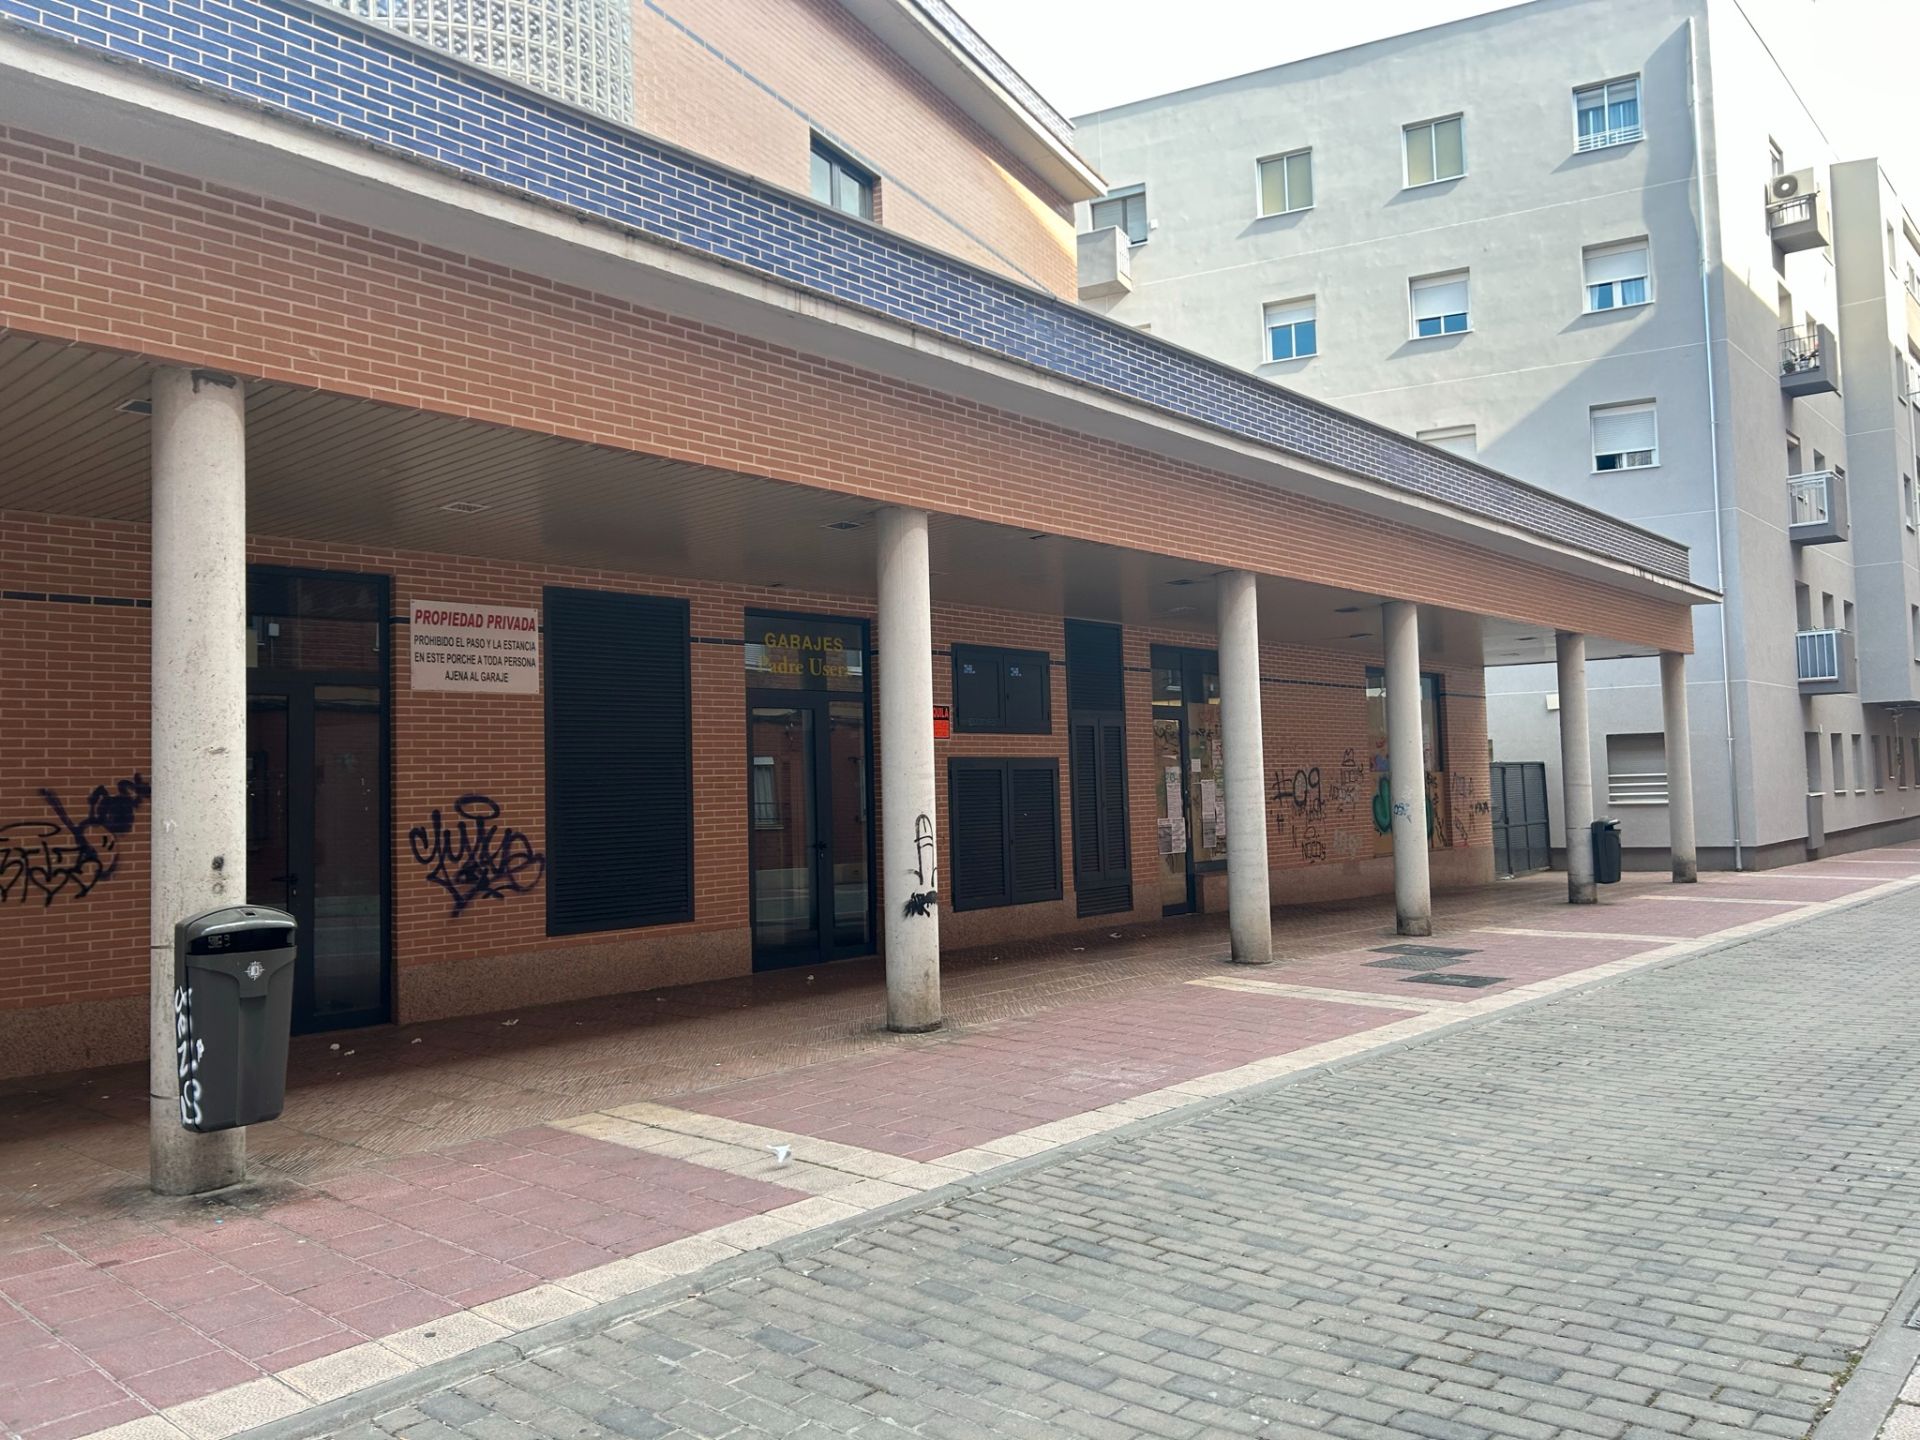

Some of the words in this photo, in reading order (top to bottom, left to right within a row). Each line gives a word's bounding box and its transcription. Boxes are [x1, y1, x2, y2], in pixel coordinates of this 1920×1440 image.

[414, 609, 483, 628] PROPIEDAD
[486, 614, 536, 632] PRIVADA
[414, 635, 454, 647] PROHIBIDO
[456, 637, 465, 648] EL
[466, 638, 486, 649] PASO
[487, 640, 491, 649] Y
[492, 640, 502, 650] LA
[503, 640, 536, 651] ESTANCIA
[764, 632, 844, 652] GARAJES
[414, 652, 425, 663] EN
[427, 653, 445, 664] ESTE
[446, 654, 476, 666] PORCHE
[477, 657, 482, 666] A
[483, 657, 503, 667] TODA
[503, 658, 536, 668] PERSONA
[758, 655, 804, 675] Padre
[445, 670, 469, 682] AJENA
[470, 672, 479, 683] AL
[480, 673, 509, 684] GARAJE
